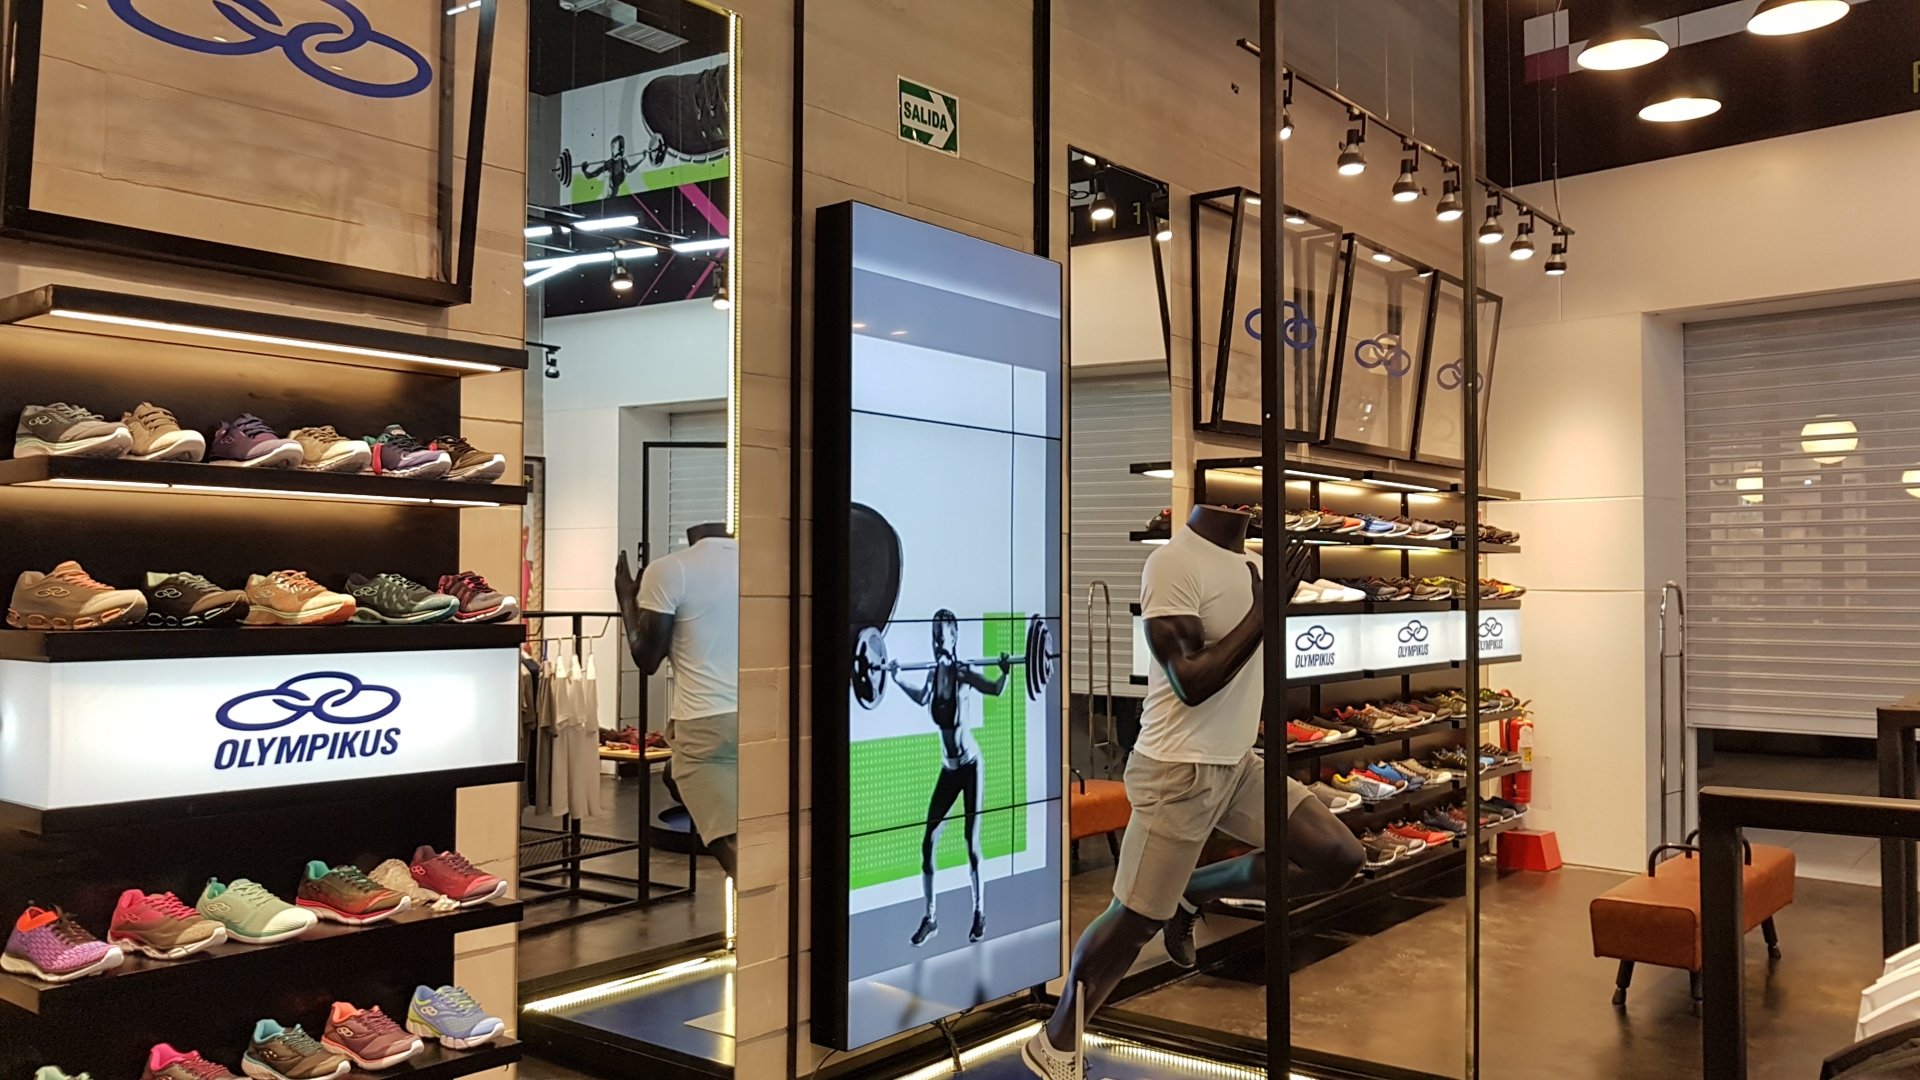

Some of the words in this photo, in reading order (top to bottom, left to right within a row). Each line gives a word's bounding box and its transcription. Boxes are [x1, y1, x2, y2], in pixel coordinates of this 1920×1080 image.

[903, 101, 948, 132] SALIDA
[1295, 652, 1335, 668] OLYMPIKUS
[1397, 643, 1429, 658] OLYMPIKUS
[214, 727, 401, 770] OLYMPIKUS
